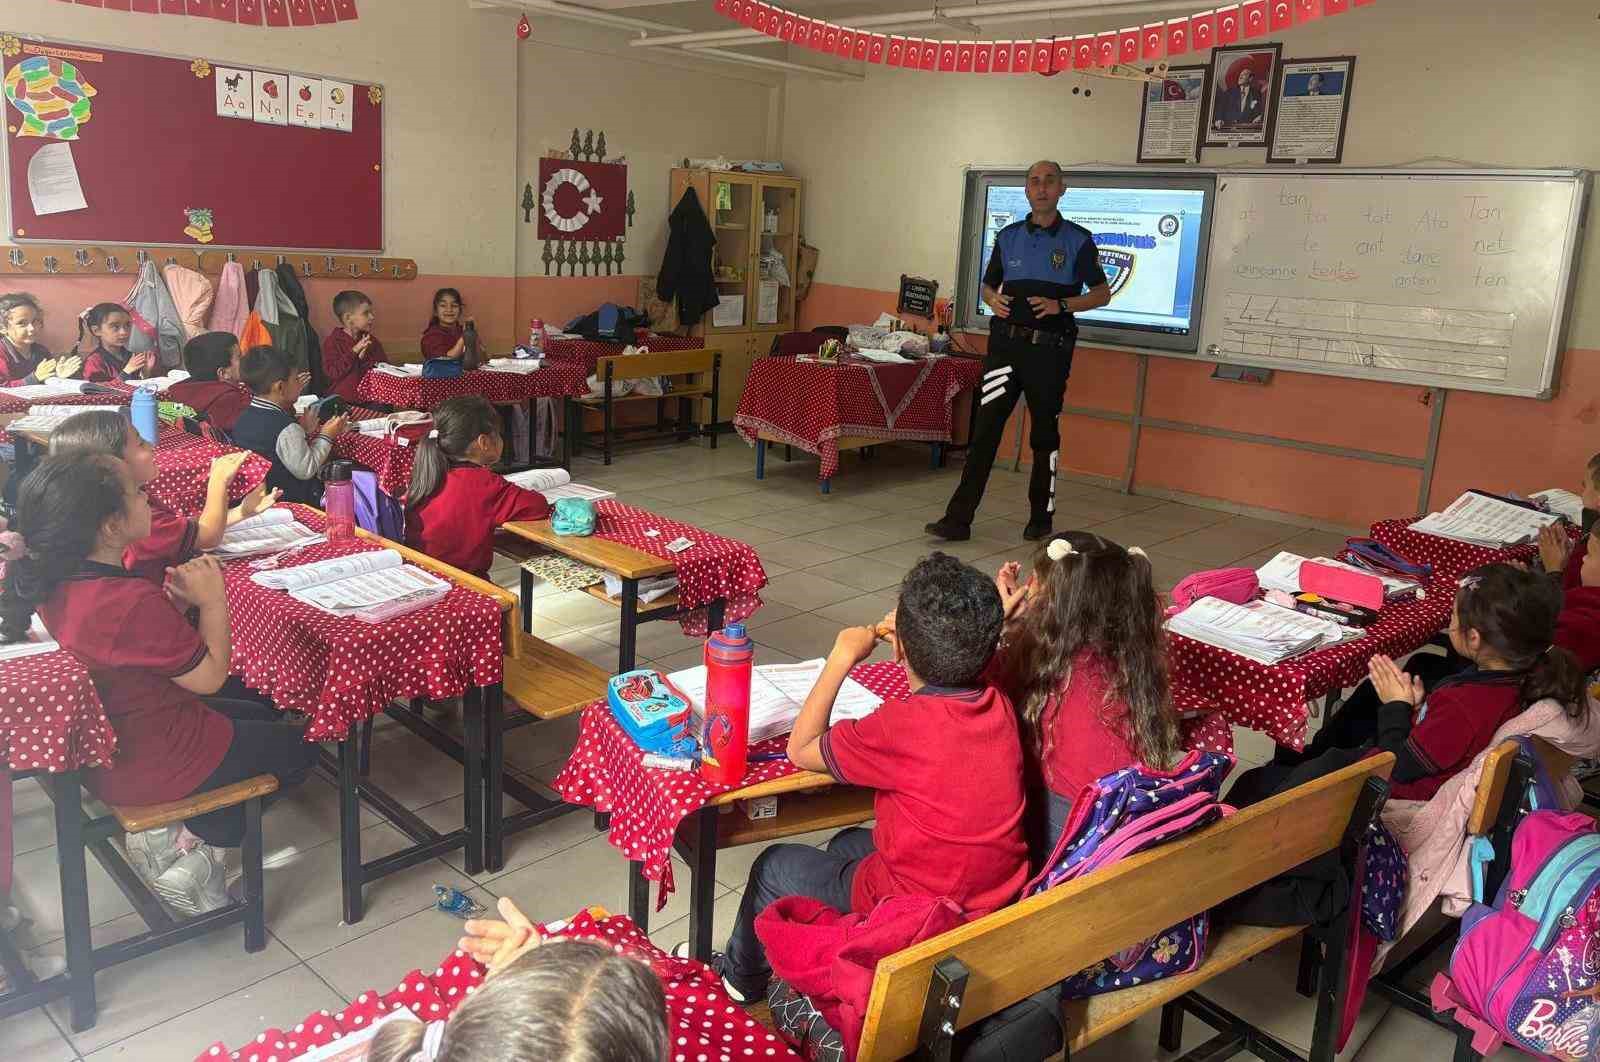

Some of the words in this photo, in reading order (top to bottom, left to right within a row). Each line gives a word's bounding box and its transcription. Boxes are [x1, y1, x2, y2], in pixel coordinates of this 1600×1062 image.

[260, 100, 271, 113] N
[296, 104, 304, 117] E
[328, 107, 336, 119] T
[1464, 195, 1503, 219] Tan
[1472, 266, 1508, 287] ten
[1517, 998, 1590, 1058] Barbie
